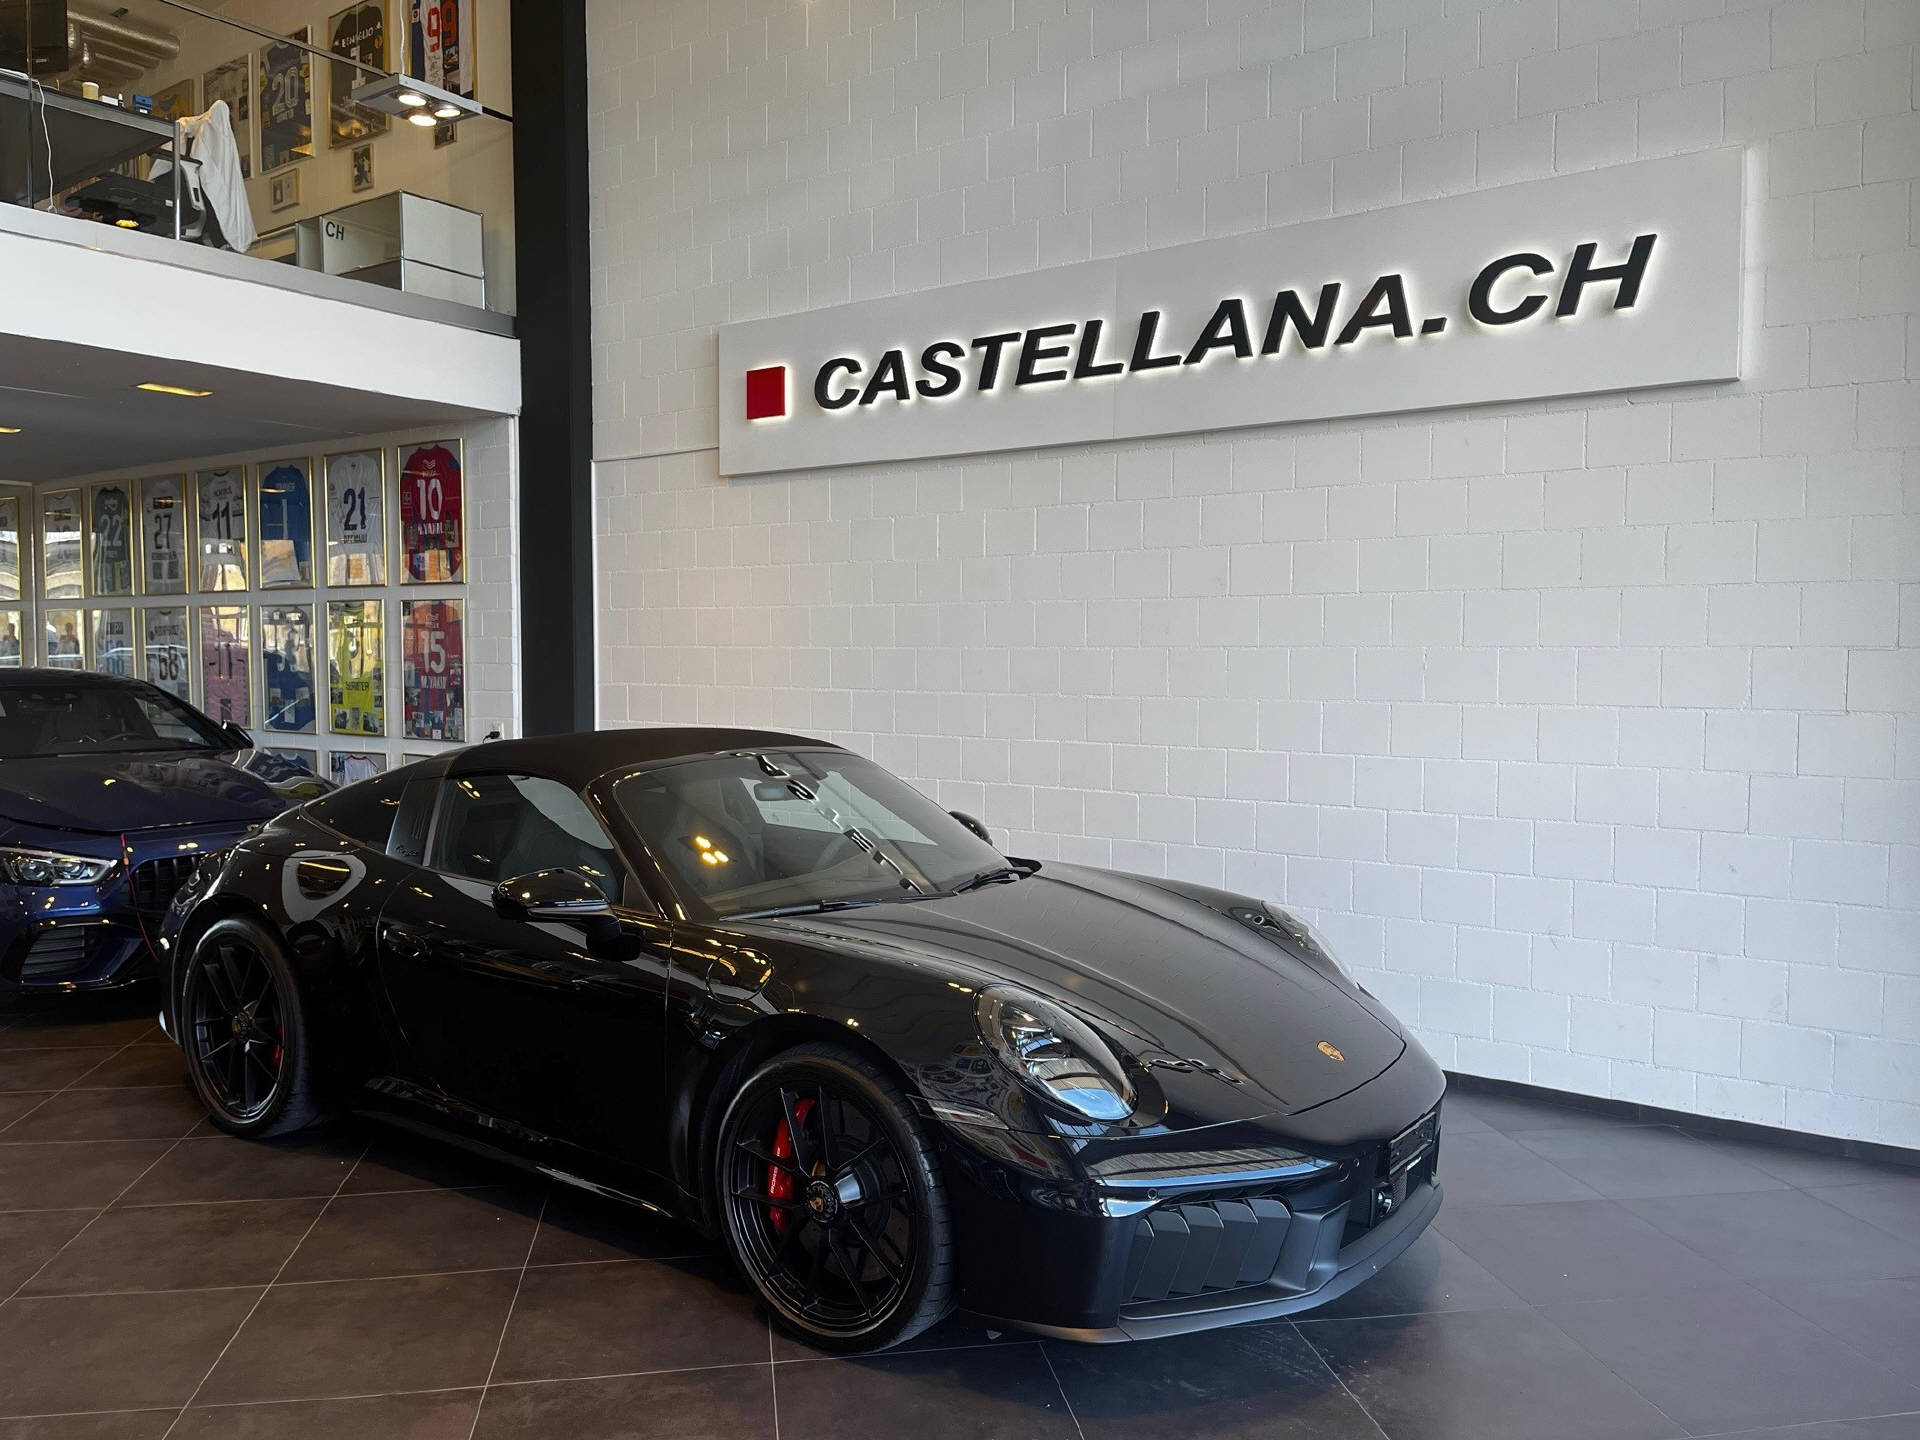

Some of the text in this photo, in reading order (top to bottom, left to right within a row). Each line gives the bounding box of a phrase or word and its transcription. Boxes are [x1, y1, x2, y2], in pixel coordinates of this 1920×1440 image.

[272, 66, 299, 116] 20
[325, 221, 345, 240] CH
[814, 233, 1657, 410] CASTELLANA.CH
[212, 501, 231, 539] 11
[343, 487, 366, 530] 21
[417, 478, 443, 520] 10
[101, 514, 123, 547] 22
[154, 512, 172, 549] 27
[420, 630, 446, 673] 15
